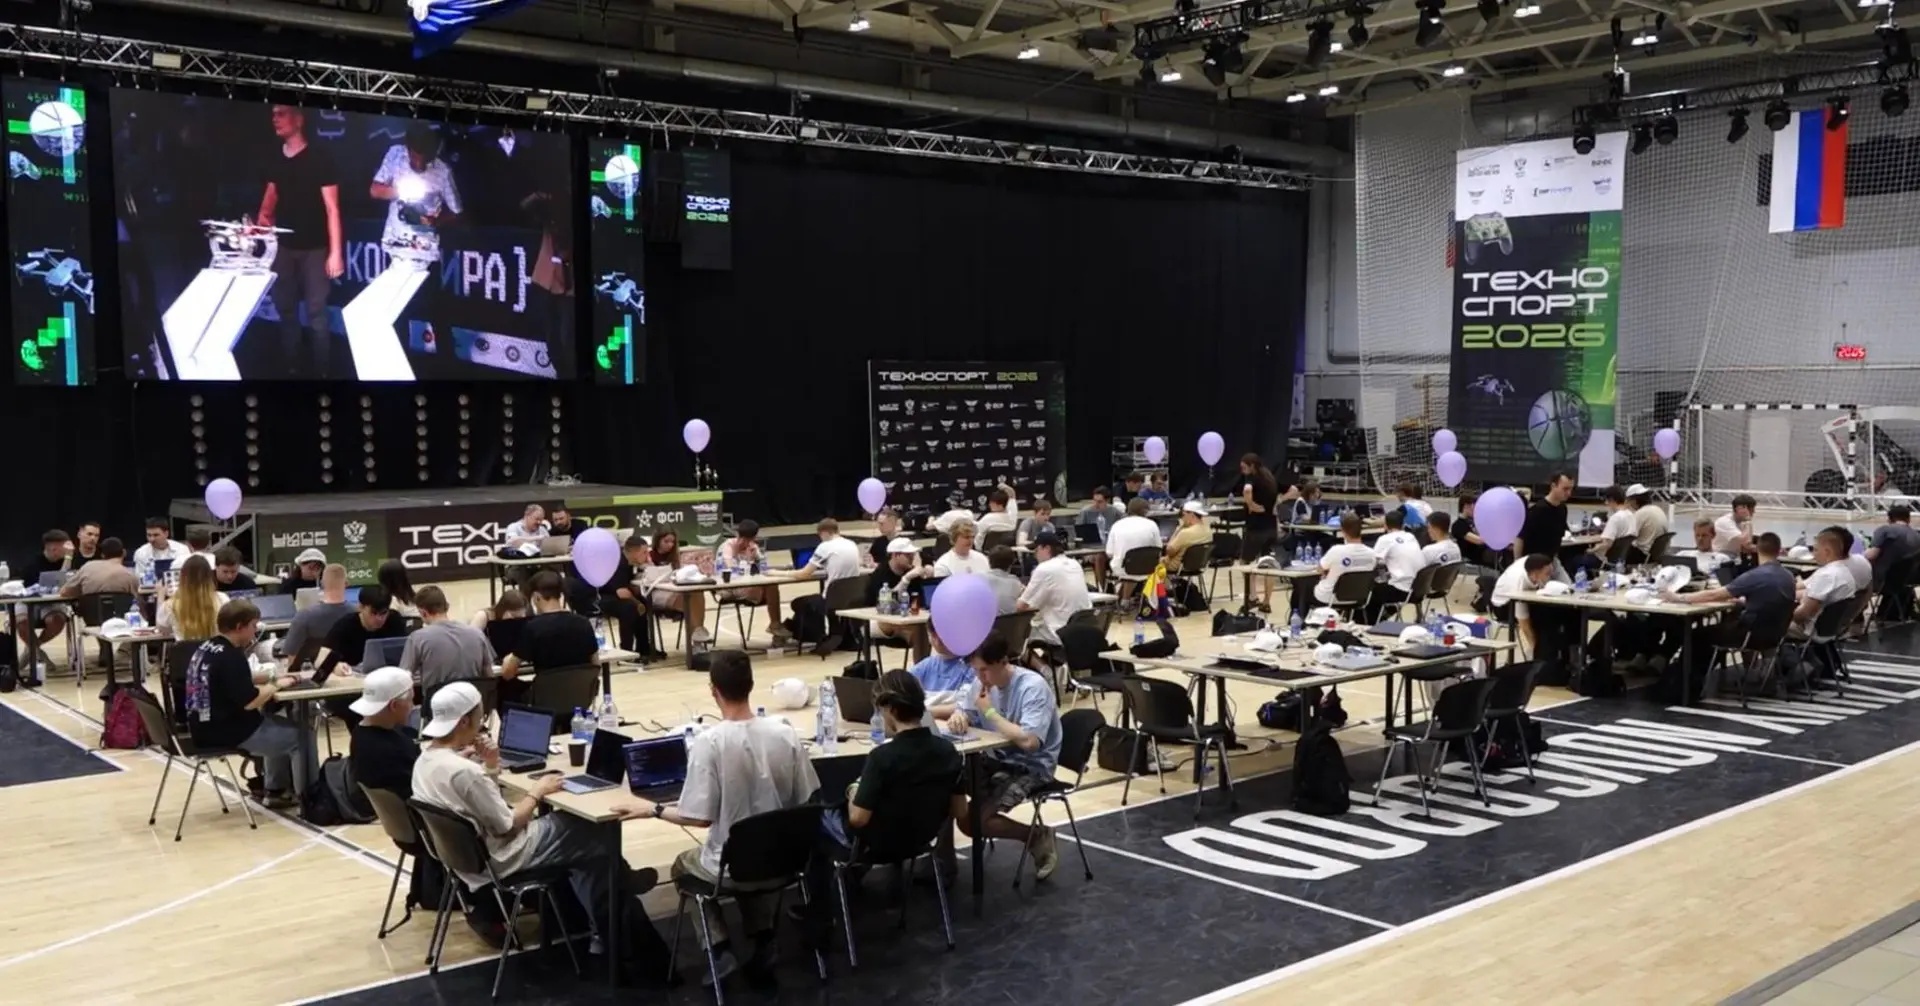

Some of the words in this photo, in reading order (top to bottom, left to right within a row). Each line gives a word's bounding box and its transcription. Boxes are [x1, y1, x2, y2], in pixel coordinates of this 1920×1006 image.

[686, 195, 730, 205] ТЕХНО
[686, 202, 730, 212] СПОРТ
[686, 211, 729, 222] 2026
[1462, 267, 1609, 293] ТЕХНО
[1462, 293, 1608, 317] СПОРТ
[1462, 323, 1606, 348] 2026
[878, 371, 989, 381] ТЕХНОСПОРТ
[997, 372, 1038, 381] 2026
[656, 511, 684, 524] ФСП
[1161, 717, 1772, 881] NOVGOROD
